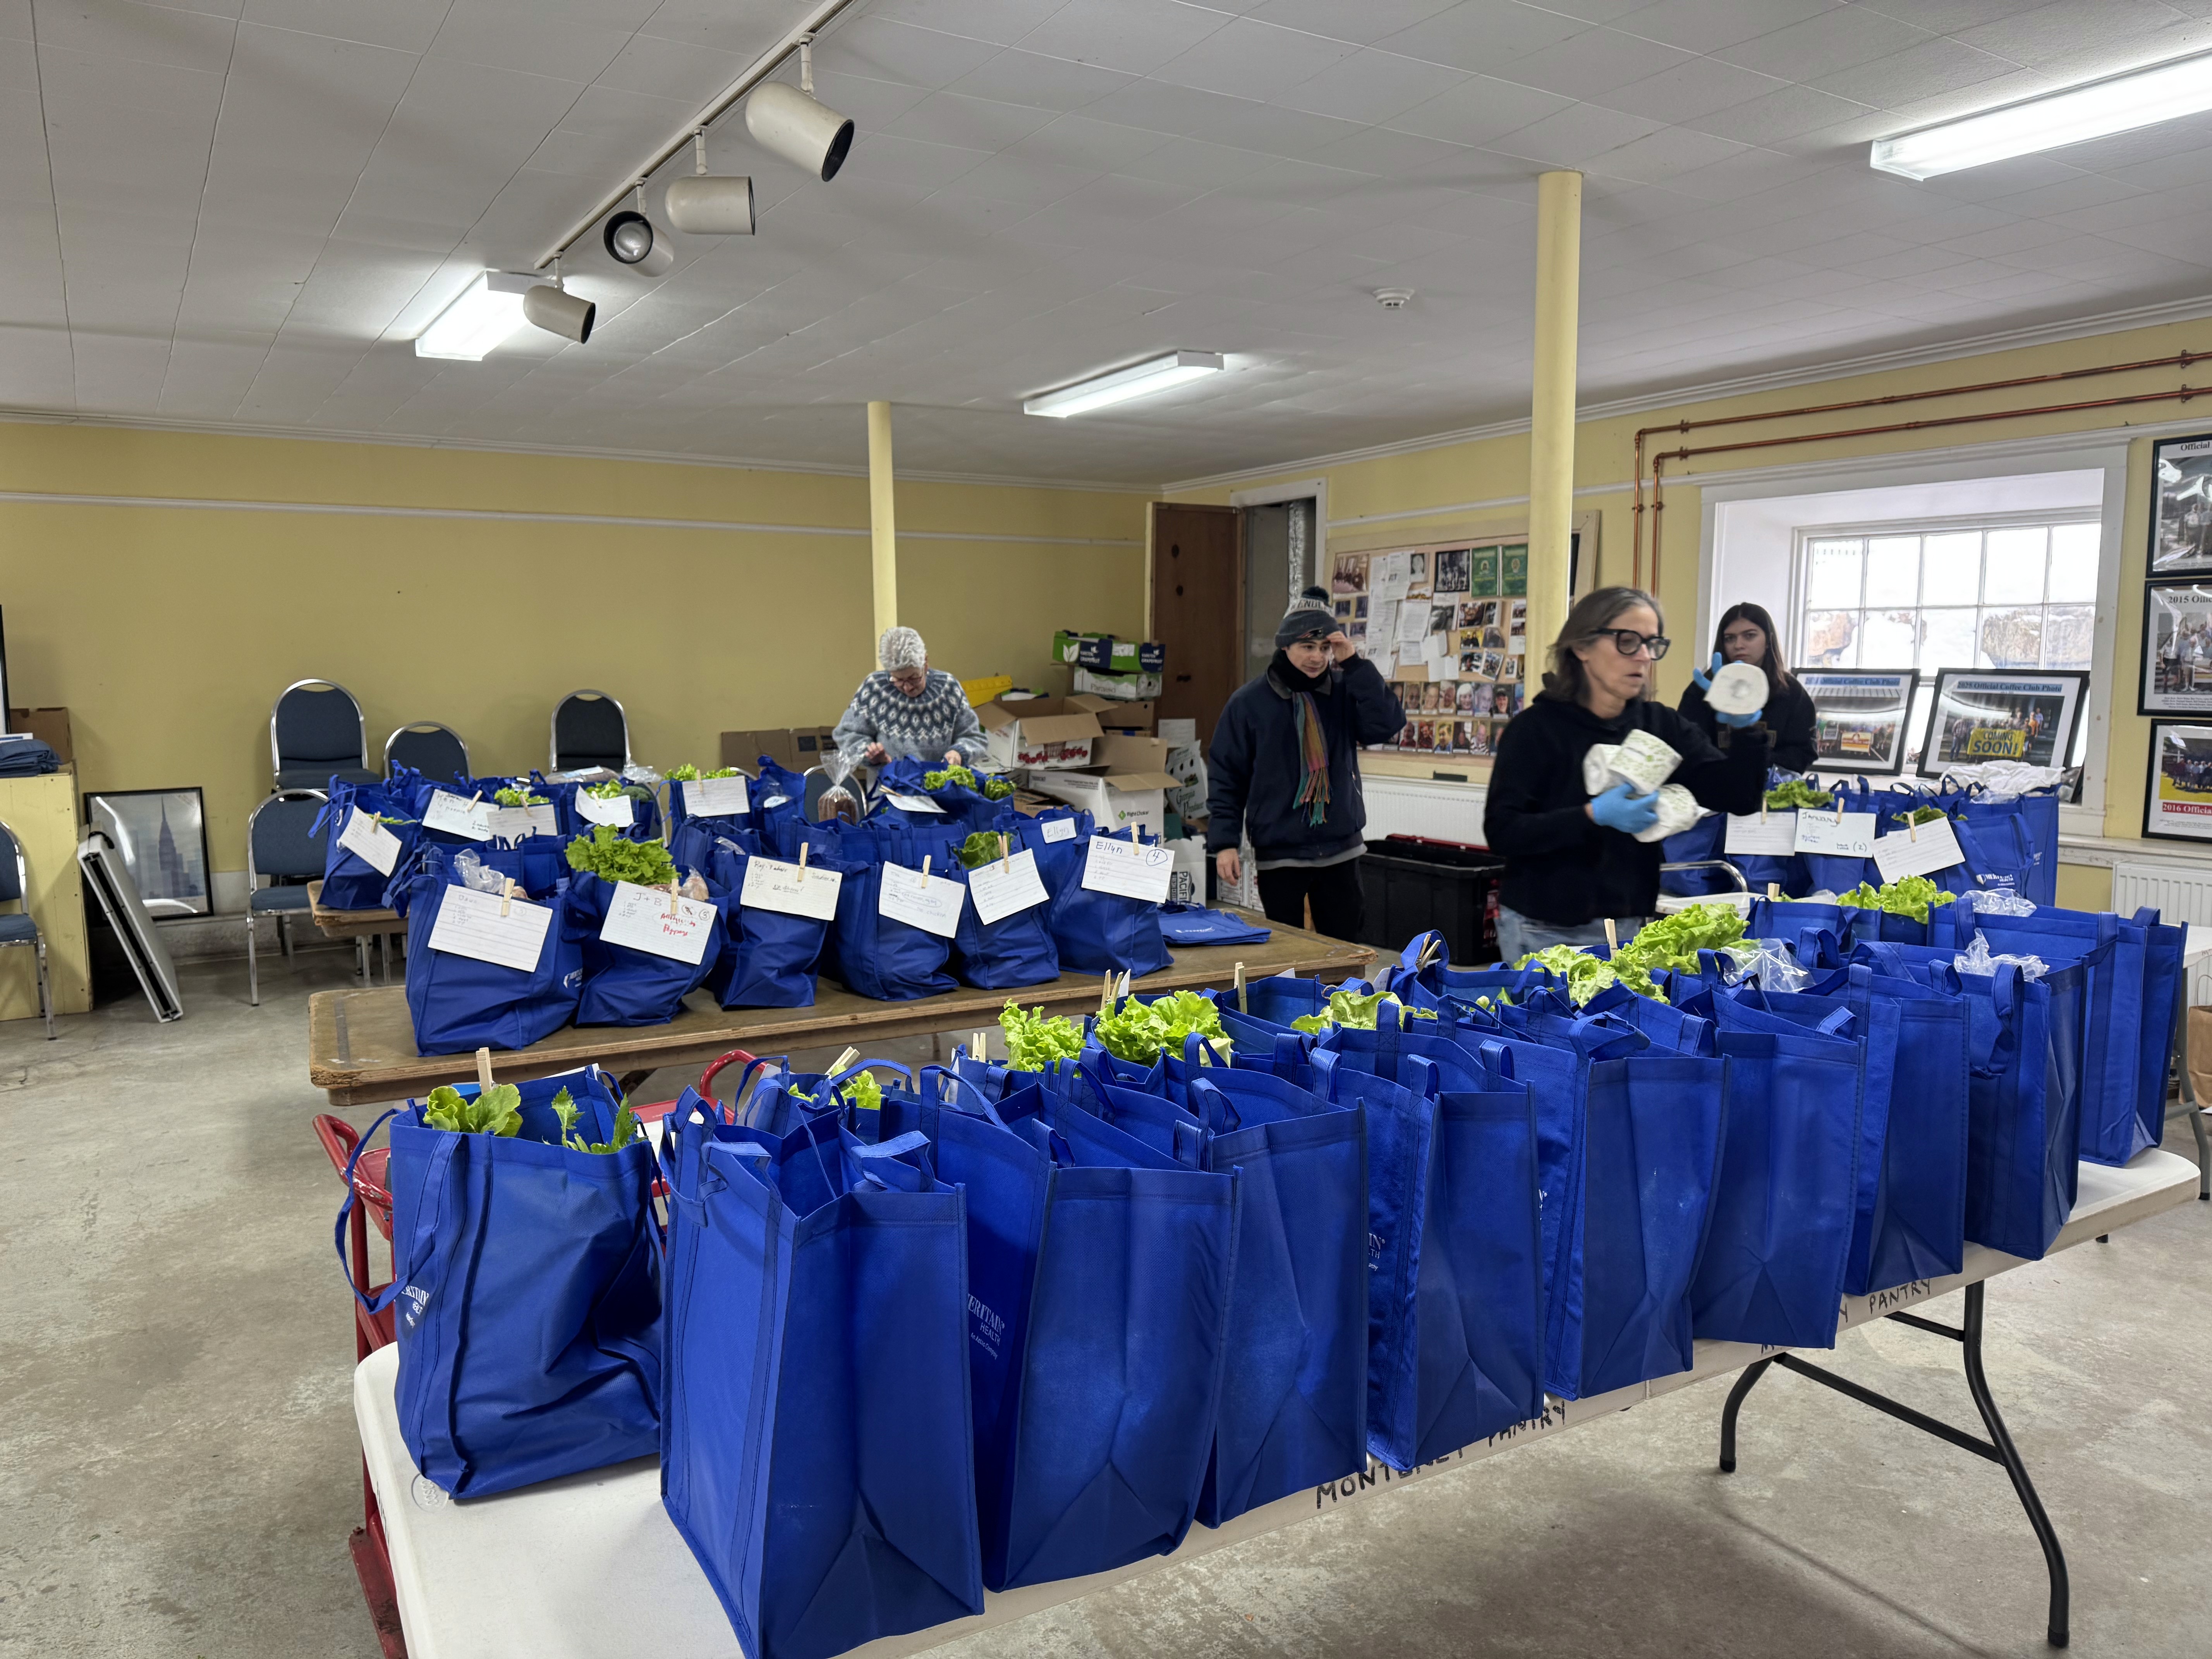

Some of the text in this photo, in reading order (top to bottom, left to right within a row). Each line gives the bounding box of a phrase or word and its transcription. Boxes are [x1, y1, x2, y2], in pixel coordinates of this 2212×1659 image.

[2180, 441, 2210, 451] Official
[2042, 684, 2062, 692] Photo
[1983, 731, 2013, 741] COMING
[1973, 741, 2018, 754] SOON!
[2163, 804, 2181, 812] 2016
[1096, 841, 1122, 854] Ellyn
[654, 897, 663, 906] B
[1869, 1279, 1931, 1314] PANTRY
[980, 1322, 1001, 1346] HEALTH
